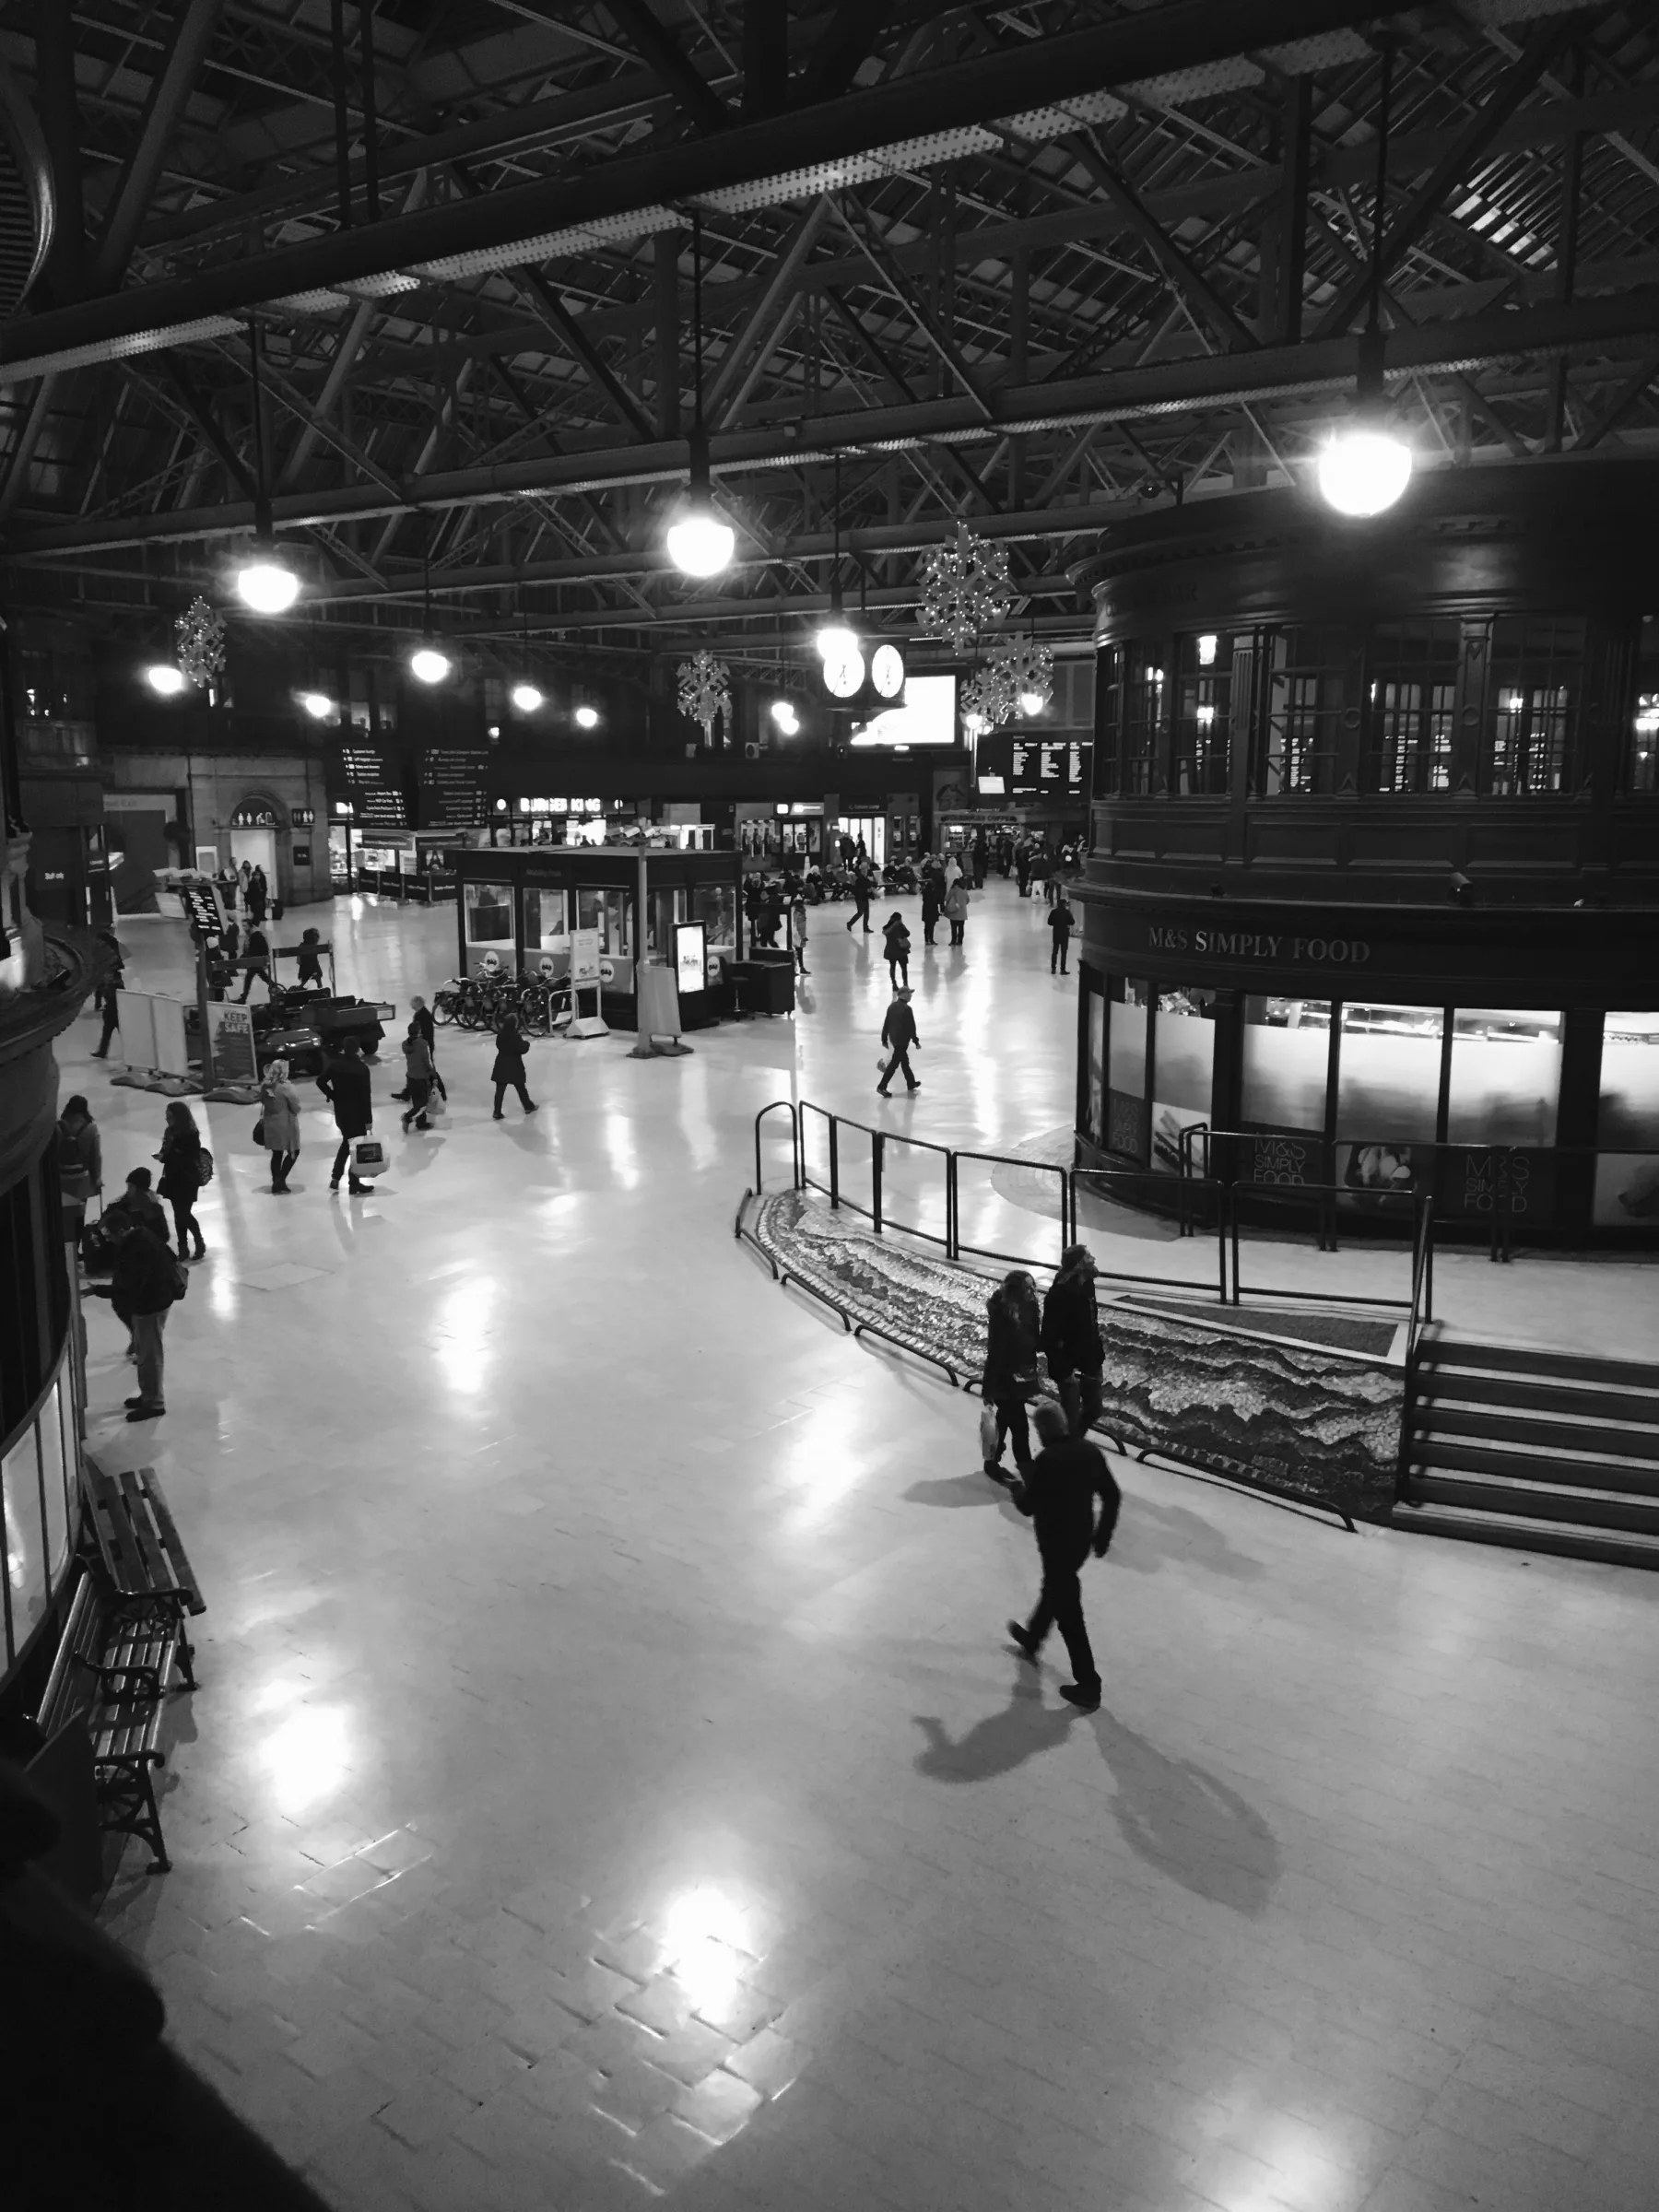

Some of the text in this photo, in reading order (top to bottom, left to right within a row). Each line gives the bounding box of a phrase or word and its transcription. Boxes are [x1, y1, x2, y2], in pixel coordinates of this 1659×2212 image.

[520, 797, 601, 812] BURGER KING
[1147, 925, 1371, 962] M&S SIMPLY FOOD
[224, 1012, 247, 1022] KEEP
[224, 1023, 249, 1034] SAFE
[1254, 1138, 1306, 1159] M&S
[1253, 1154, 1306, 1173] SIMPLY
[1253, 1168, 1305, 1185] FOOD
